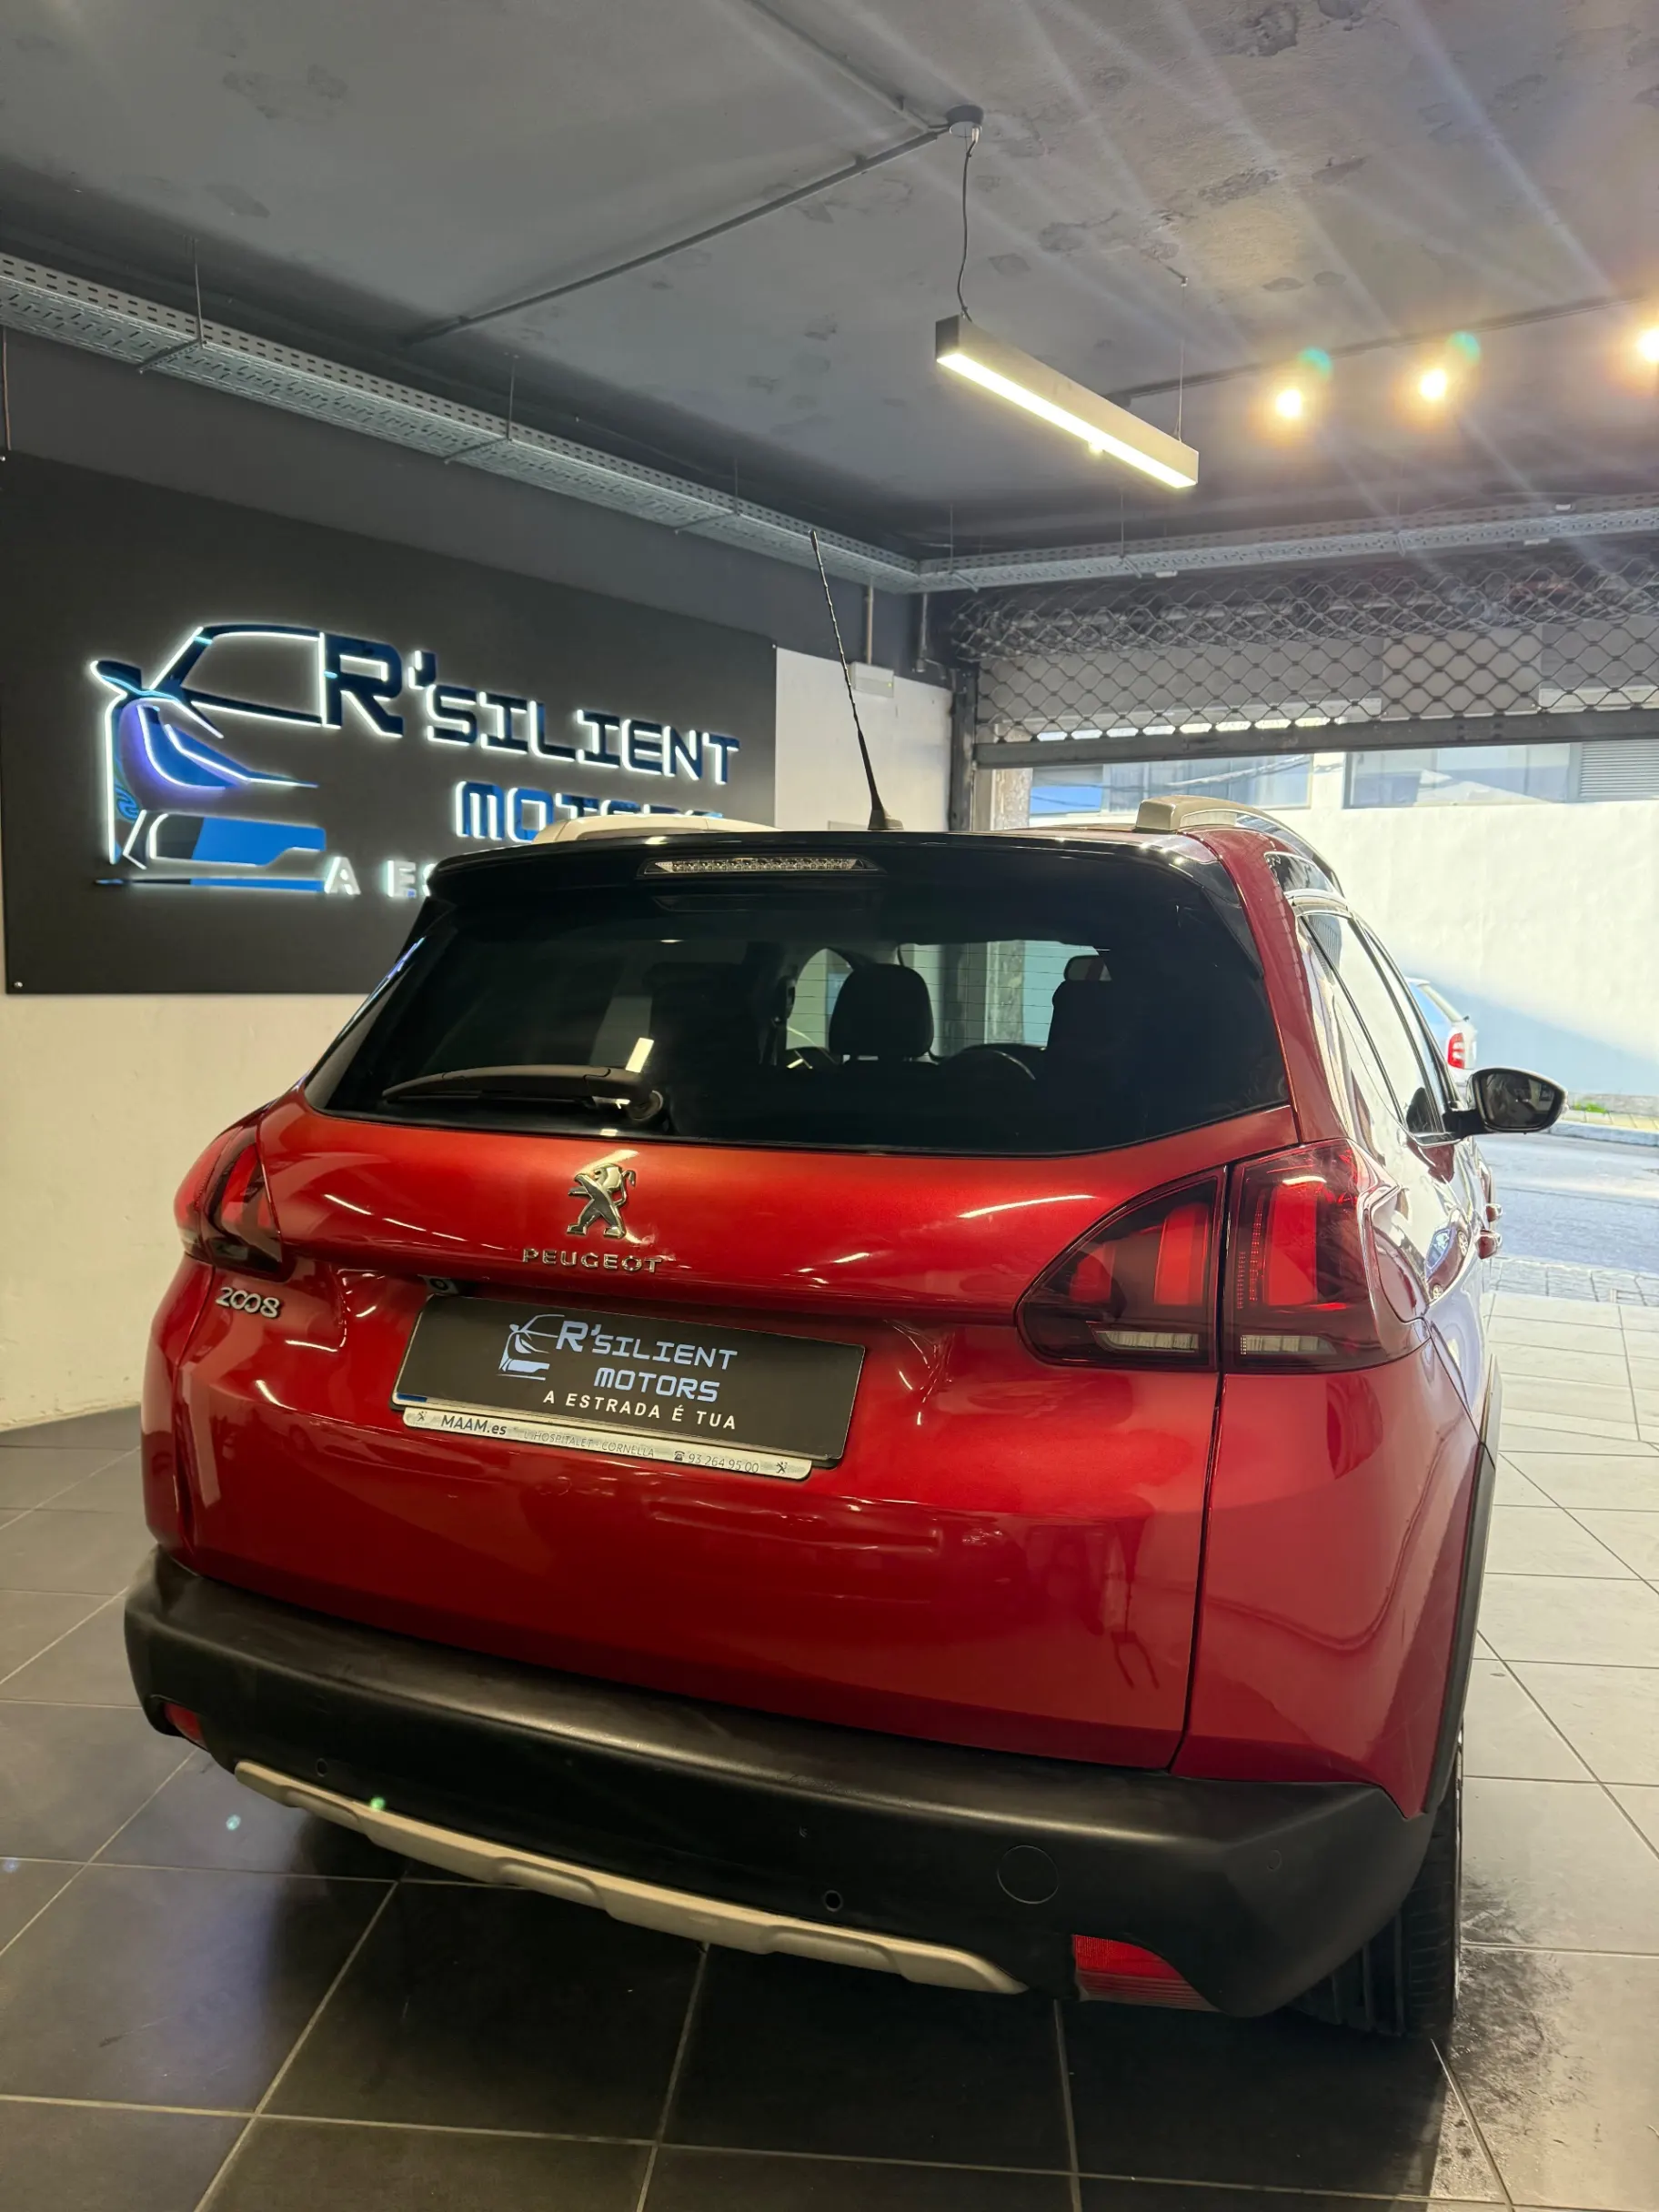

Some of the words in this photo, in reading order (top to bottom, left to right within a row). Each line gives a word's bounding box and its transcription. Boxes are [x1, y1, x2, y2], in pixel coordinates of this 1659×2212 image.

[318, 631, 741, 786] R'SILIENT
[521, 1247, 663, 1274] PEUGEOT
[216, 1285, 282, 1319] 2008
[556, 1321, 738, 1370] R'SILIENT
[593, 1367, 720, 1403] MOTORS
[543, 1390, 556, 1404] A
[565, 1393, 660, 1419] ESTRADA
[671, 1405, 684, 1423] É
[697, 1411, 736, 1430] TUA
[441, 1414, 507, 1436] MAAM.es
[688, 1453, 703, 1464] 93
[704, 1455, 726, 1468] 264
[728, 1460, 742, 1471] 95
[744, 1463, 759, 1473] 00
